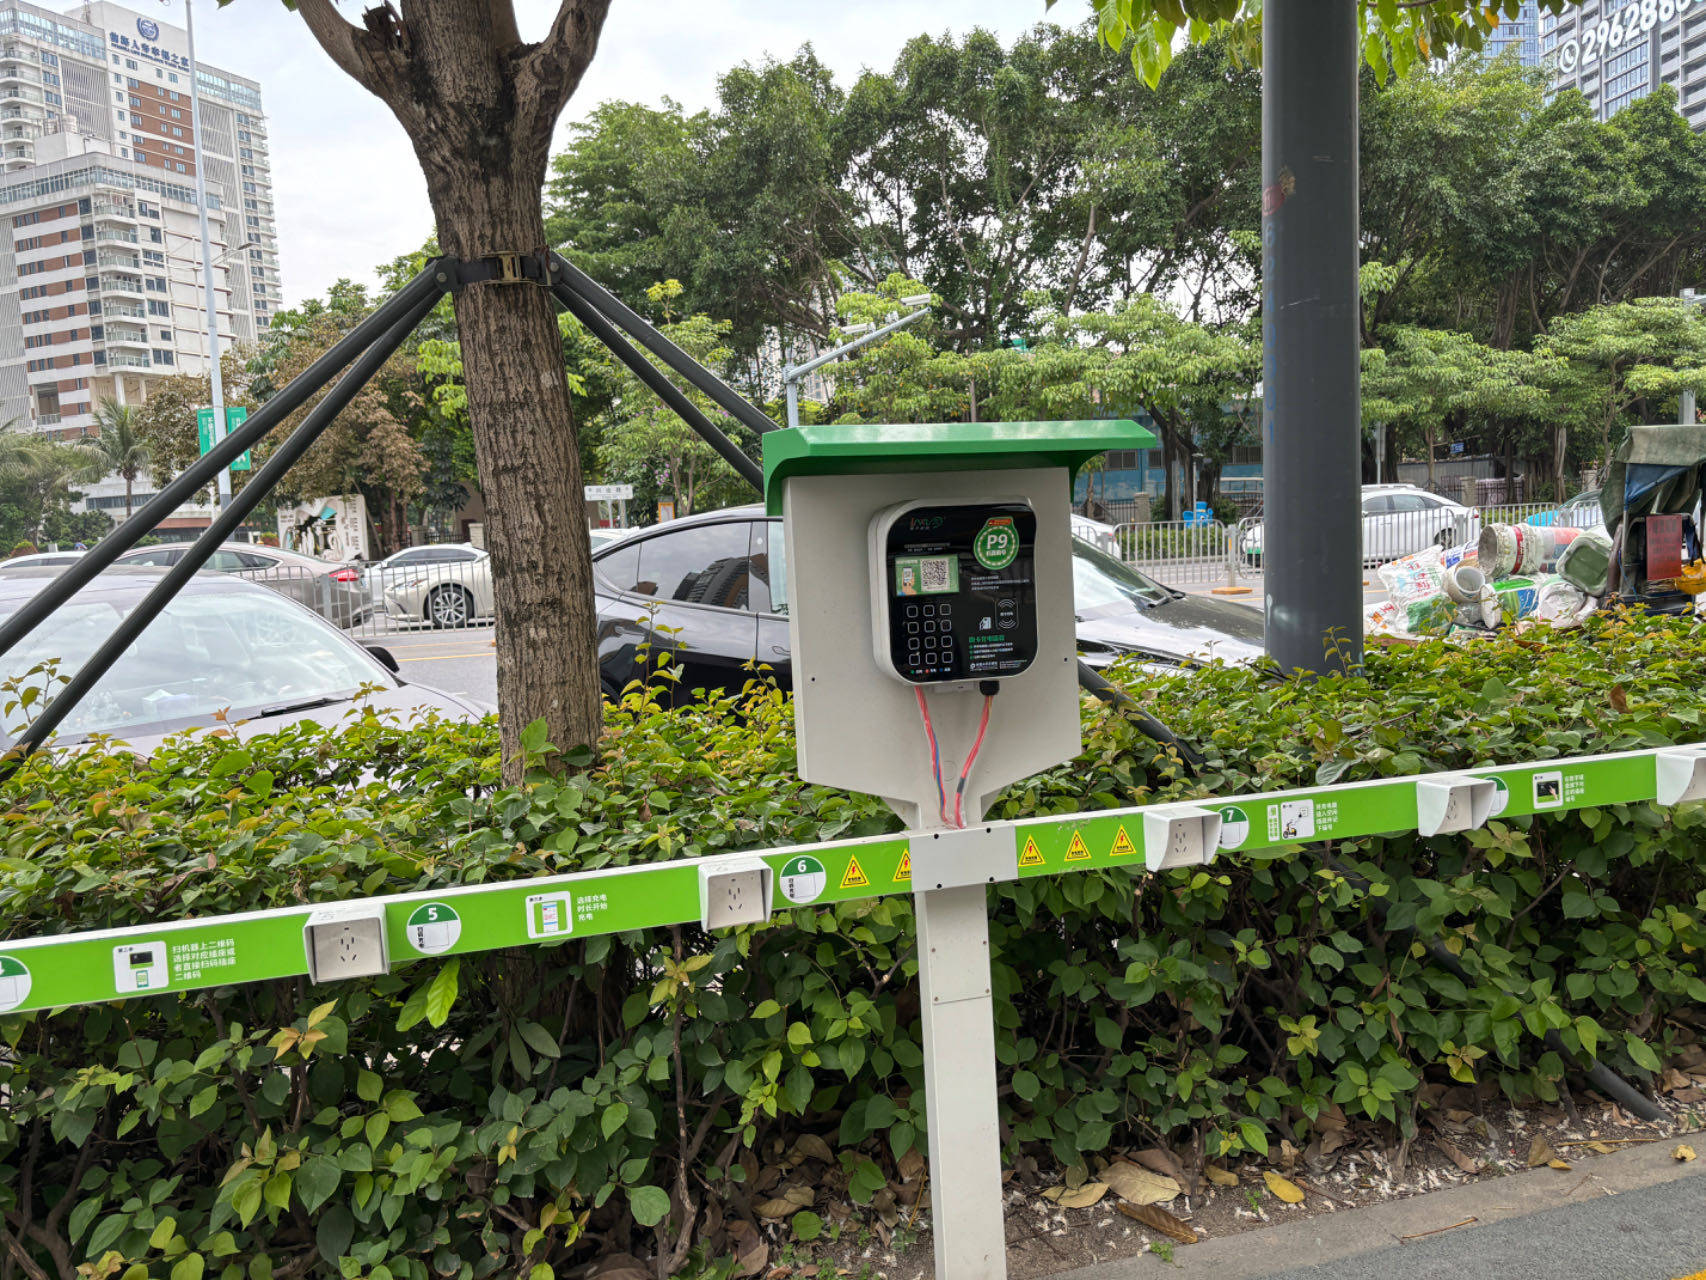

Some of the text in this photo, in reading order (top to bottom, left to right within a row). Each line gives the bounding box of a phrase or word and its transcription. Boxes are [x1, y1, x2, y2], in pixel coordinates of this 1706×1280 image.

[987, 534, 1008, 549] P9
[1227, 809, 1234, 822] 7
[798, 860, 807, 873] 6
[428, 907, 438, 920] 5
[172, 938, 235, 954] 扫机器上二维码
[173, 948, 236, 963] 选择对应插座或
[175, 970, 201, 981] 二维码
